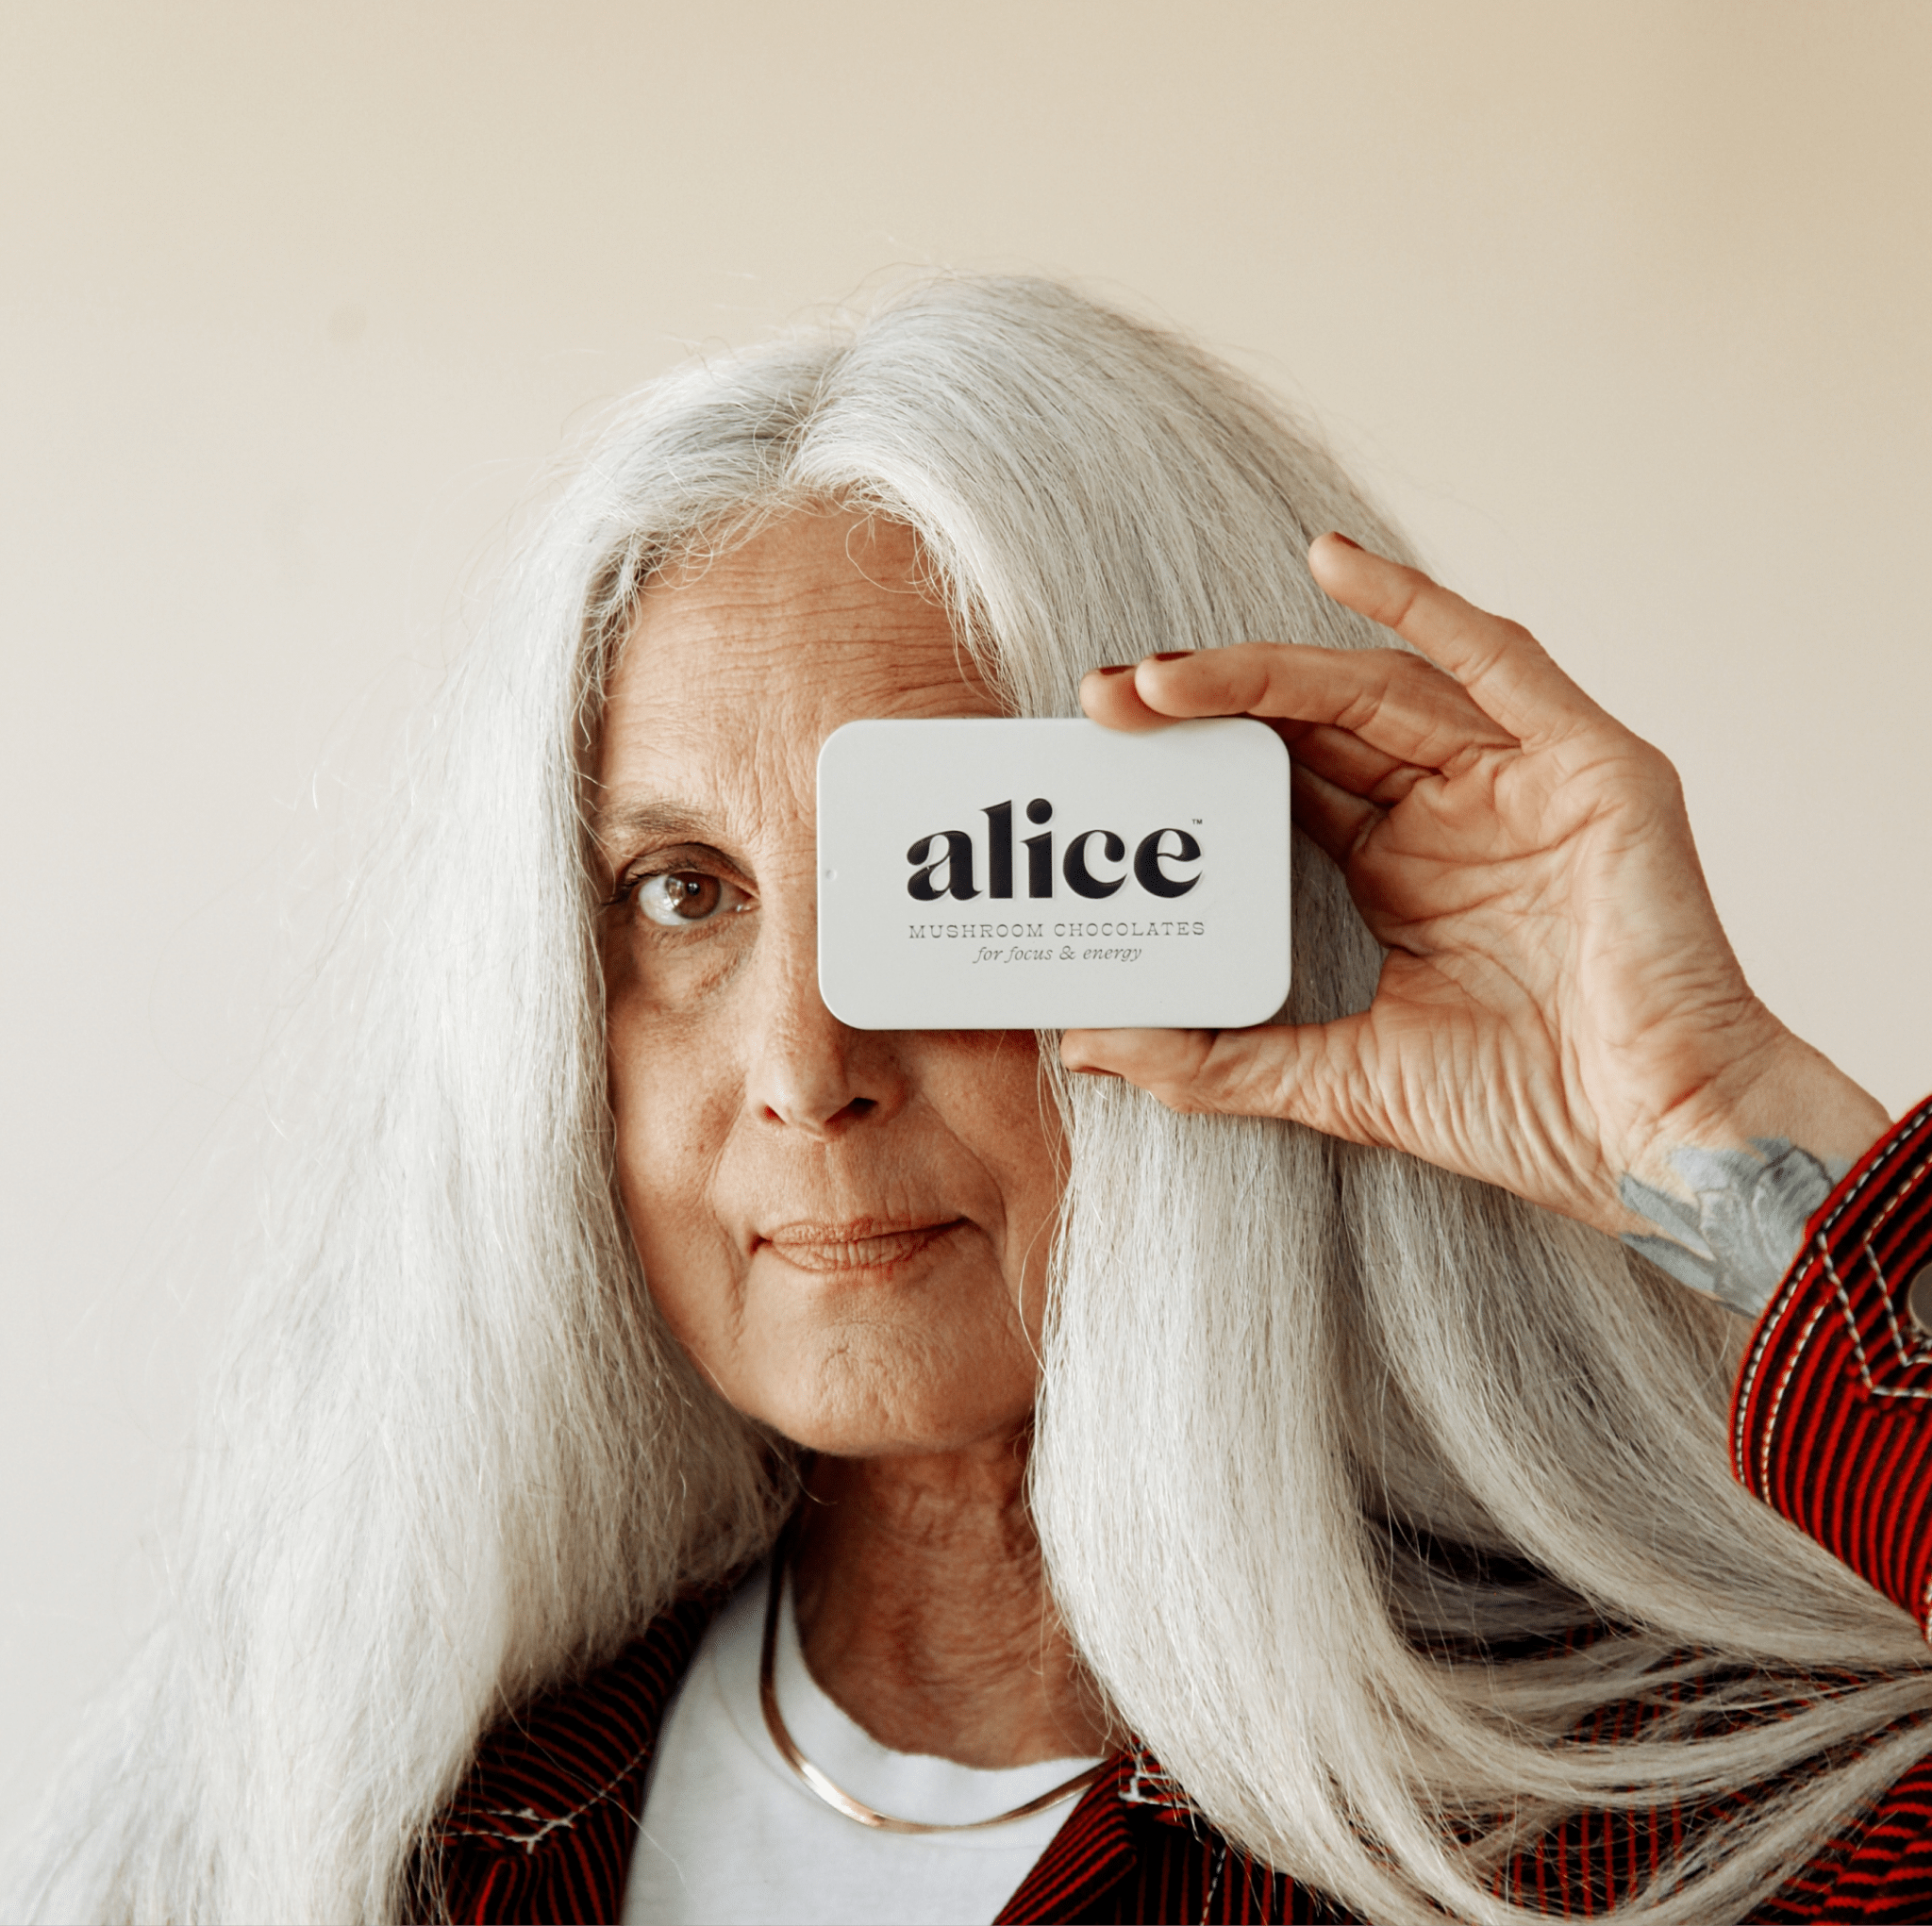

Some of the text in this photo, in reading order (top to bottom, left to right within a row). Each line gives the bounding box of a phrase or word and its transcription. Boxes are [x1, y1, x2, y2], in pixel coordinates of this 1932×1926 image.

[906, 797, 1204, 902] alice
[908, 921, 1206, 939] MUSHROOM CHOCOLATES
[973, 945, 1142, 964] for focus & energy
